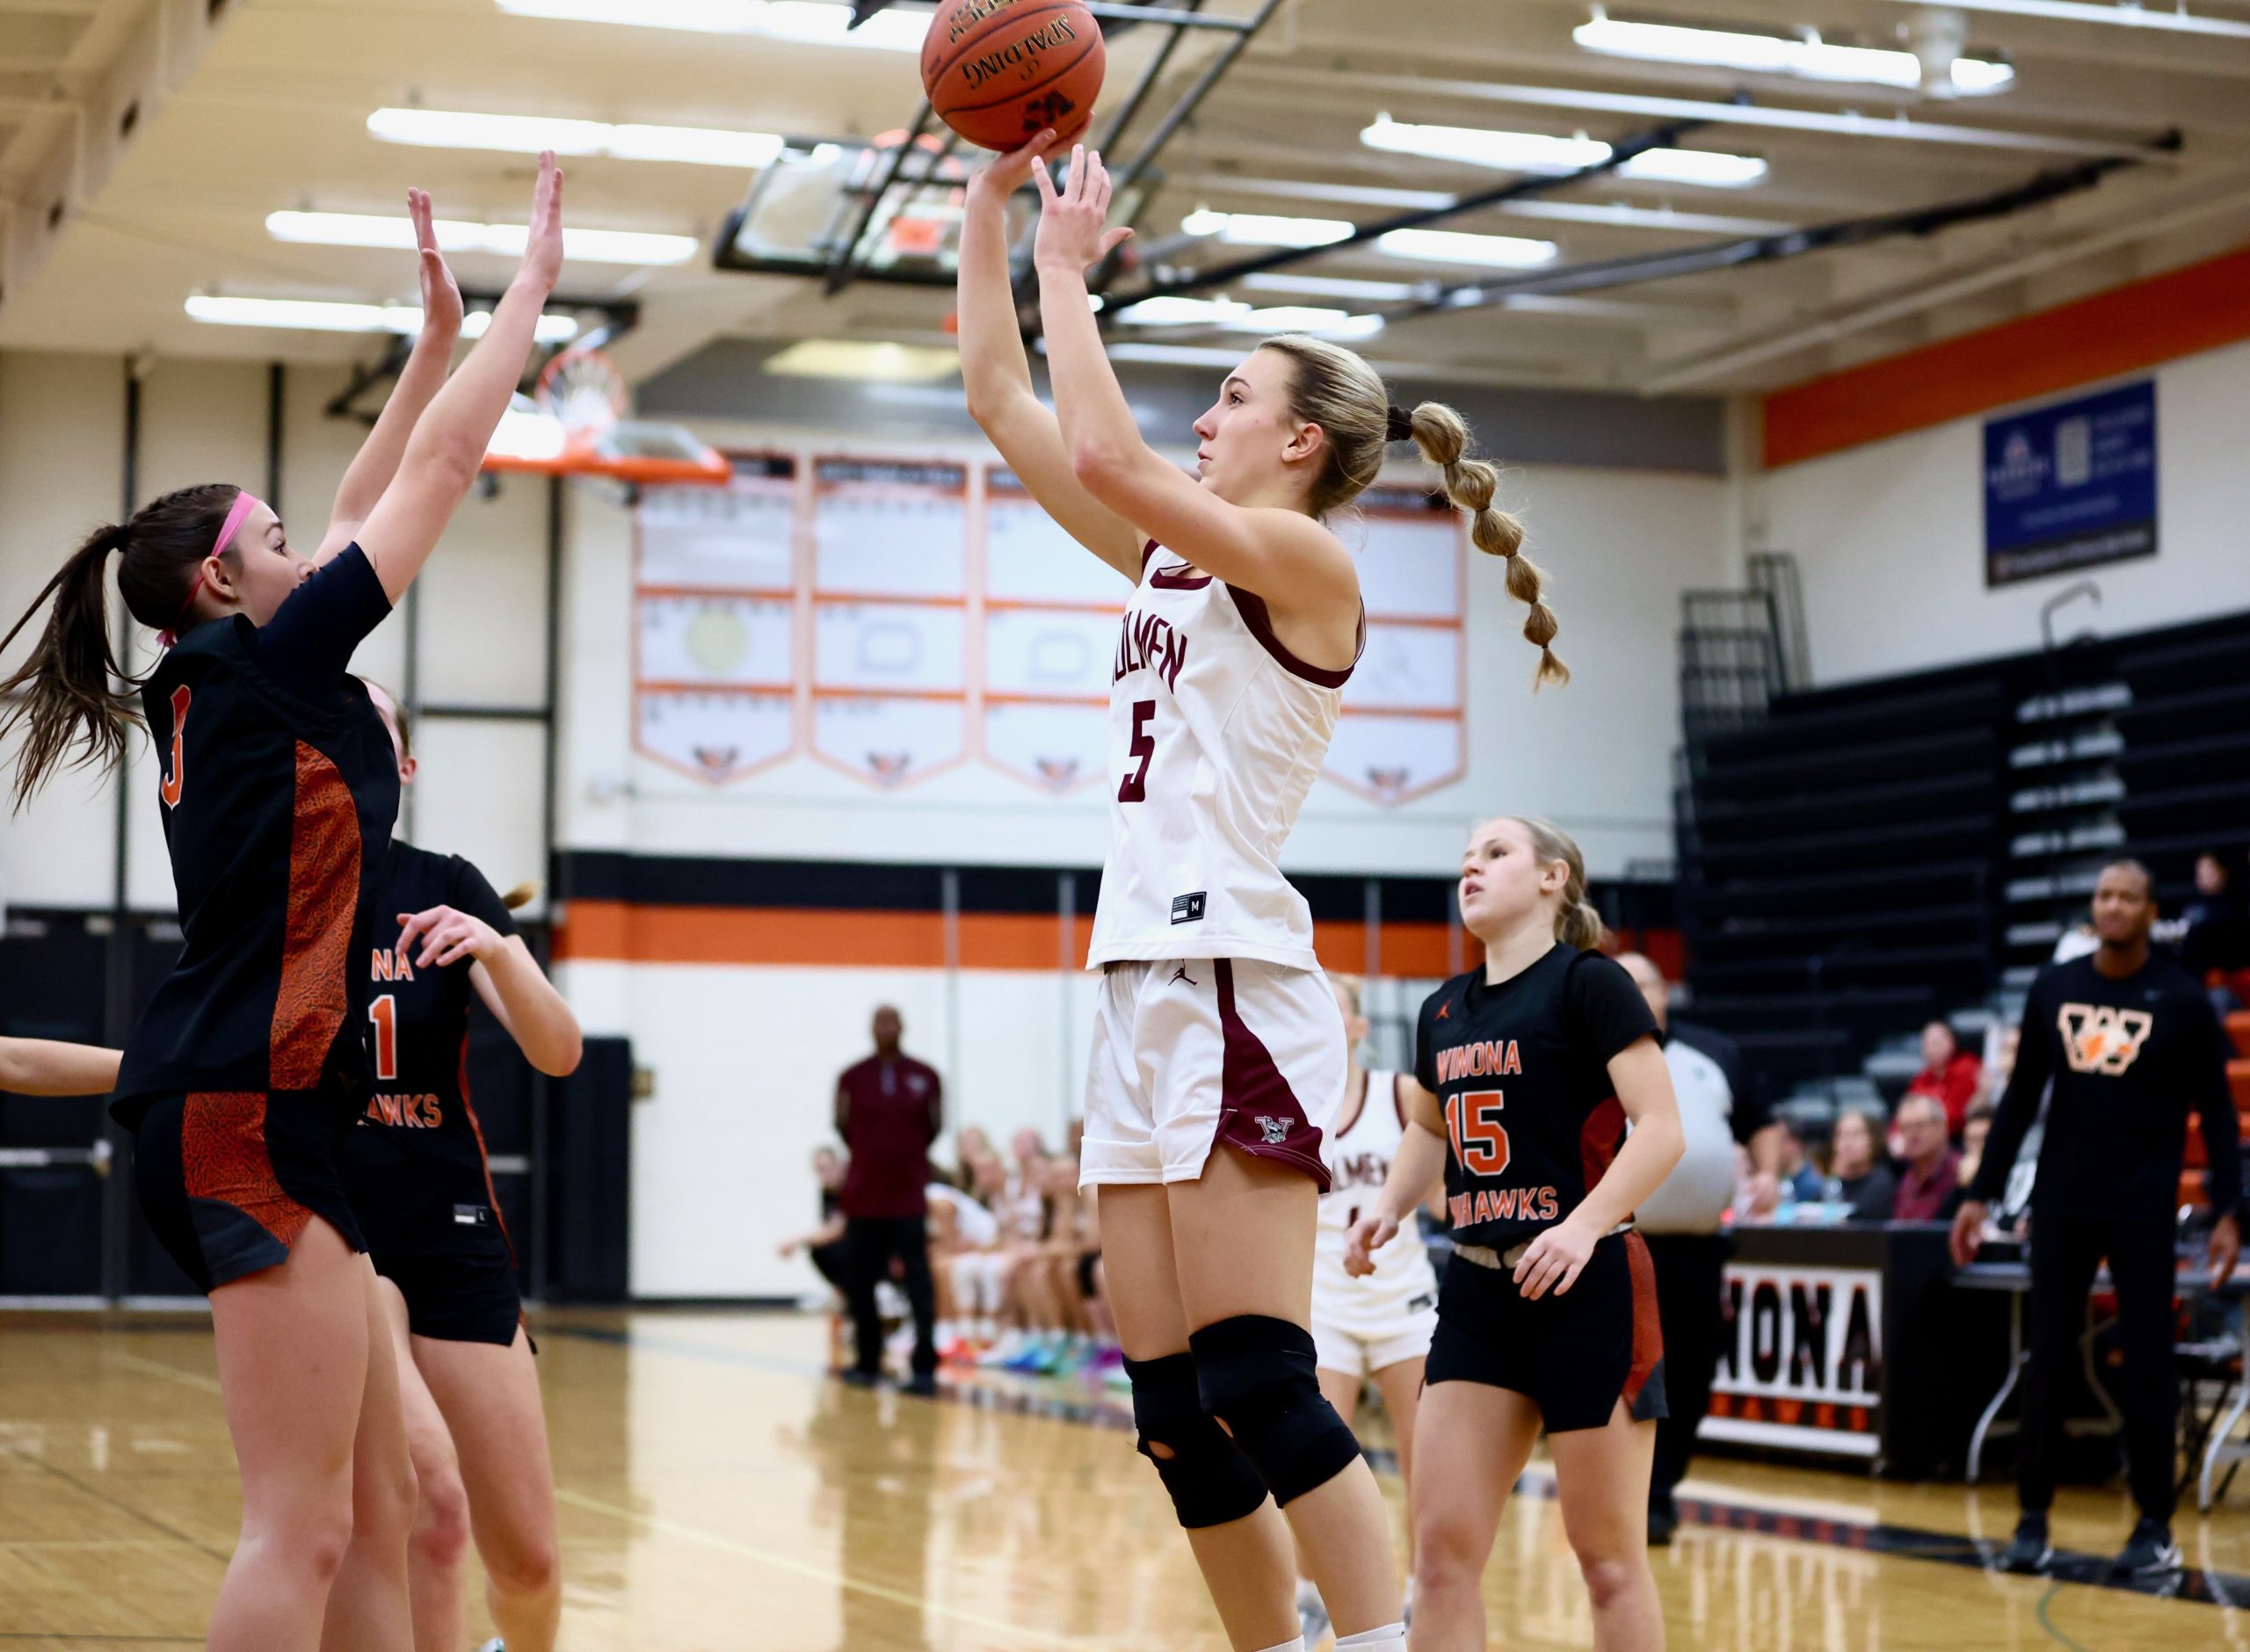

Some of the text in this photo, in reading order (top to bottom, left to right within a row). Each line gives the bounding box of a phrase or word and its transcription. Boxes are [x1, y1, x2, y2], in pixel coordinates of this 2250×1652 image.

[962, 13, 1077, 90] SPALDING
[1118, 699, 1156, 803] 5
[1191, 900, 1200, 912] M
[362, 994, 397, 1080] 1
[1436, 1040, 1522, 1085] WINONA
[357, 1093, 443, 1129] AWKS
[1445, 1090, 1511, 1177] 15
